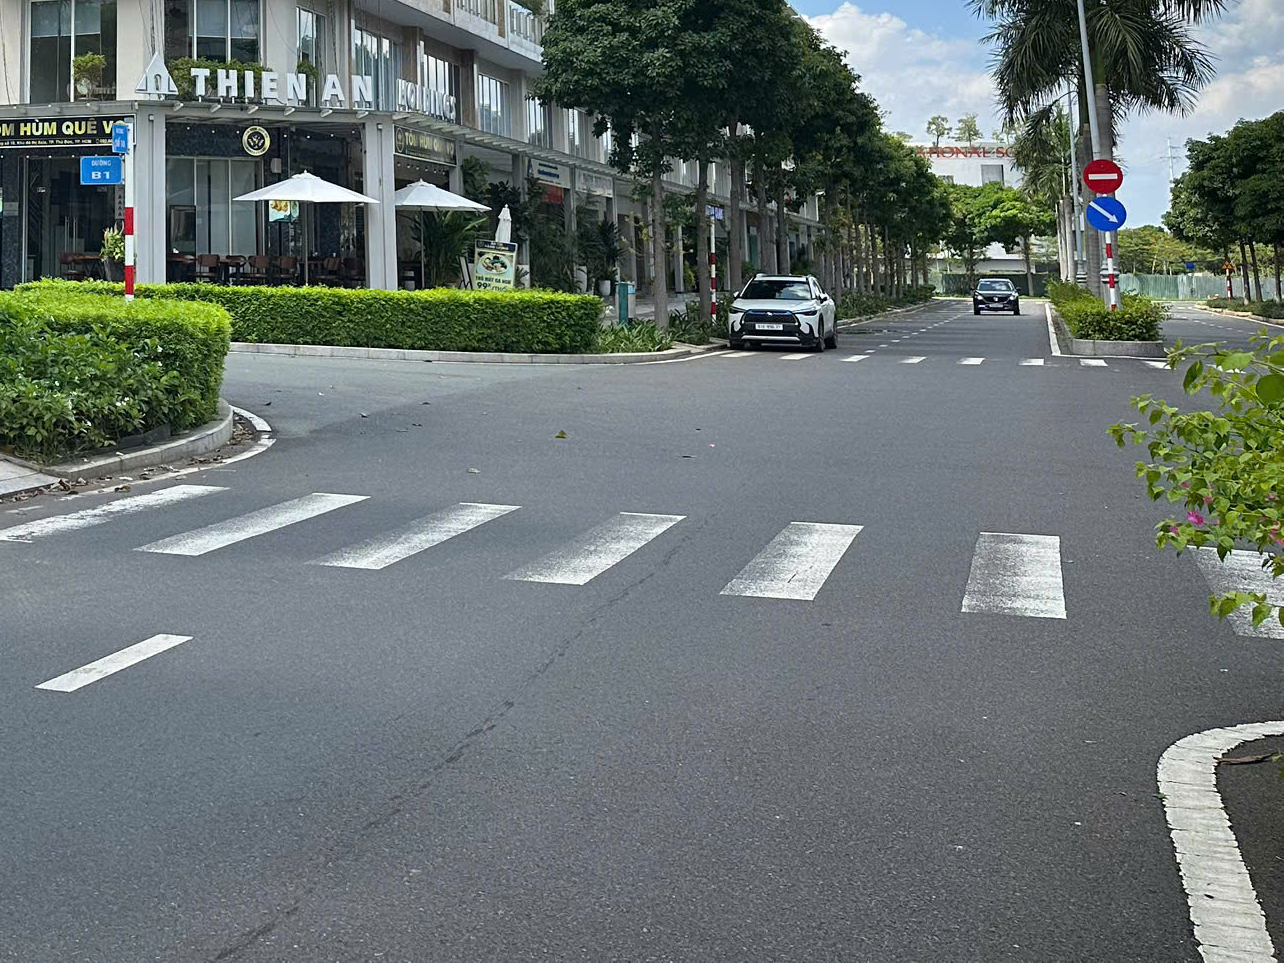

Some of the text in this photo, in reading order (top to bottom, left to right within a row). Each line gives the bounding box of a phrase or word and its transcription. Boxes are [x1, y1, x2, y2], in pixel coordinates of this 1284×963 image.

[190, 67, 306, 101] THIEN
[321, 74, 373, 103] AN
[19, 118, 57, 136] HÙM
[62, 118, 97, 136] QUÊ
[91, 171, 110, 180] B1
